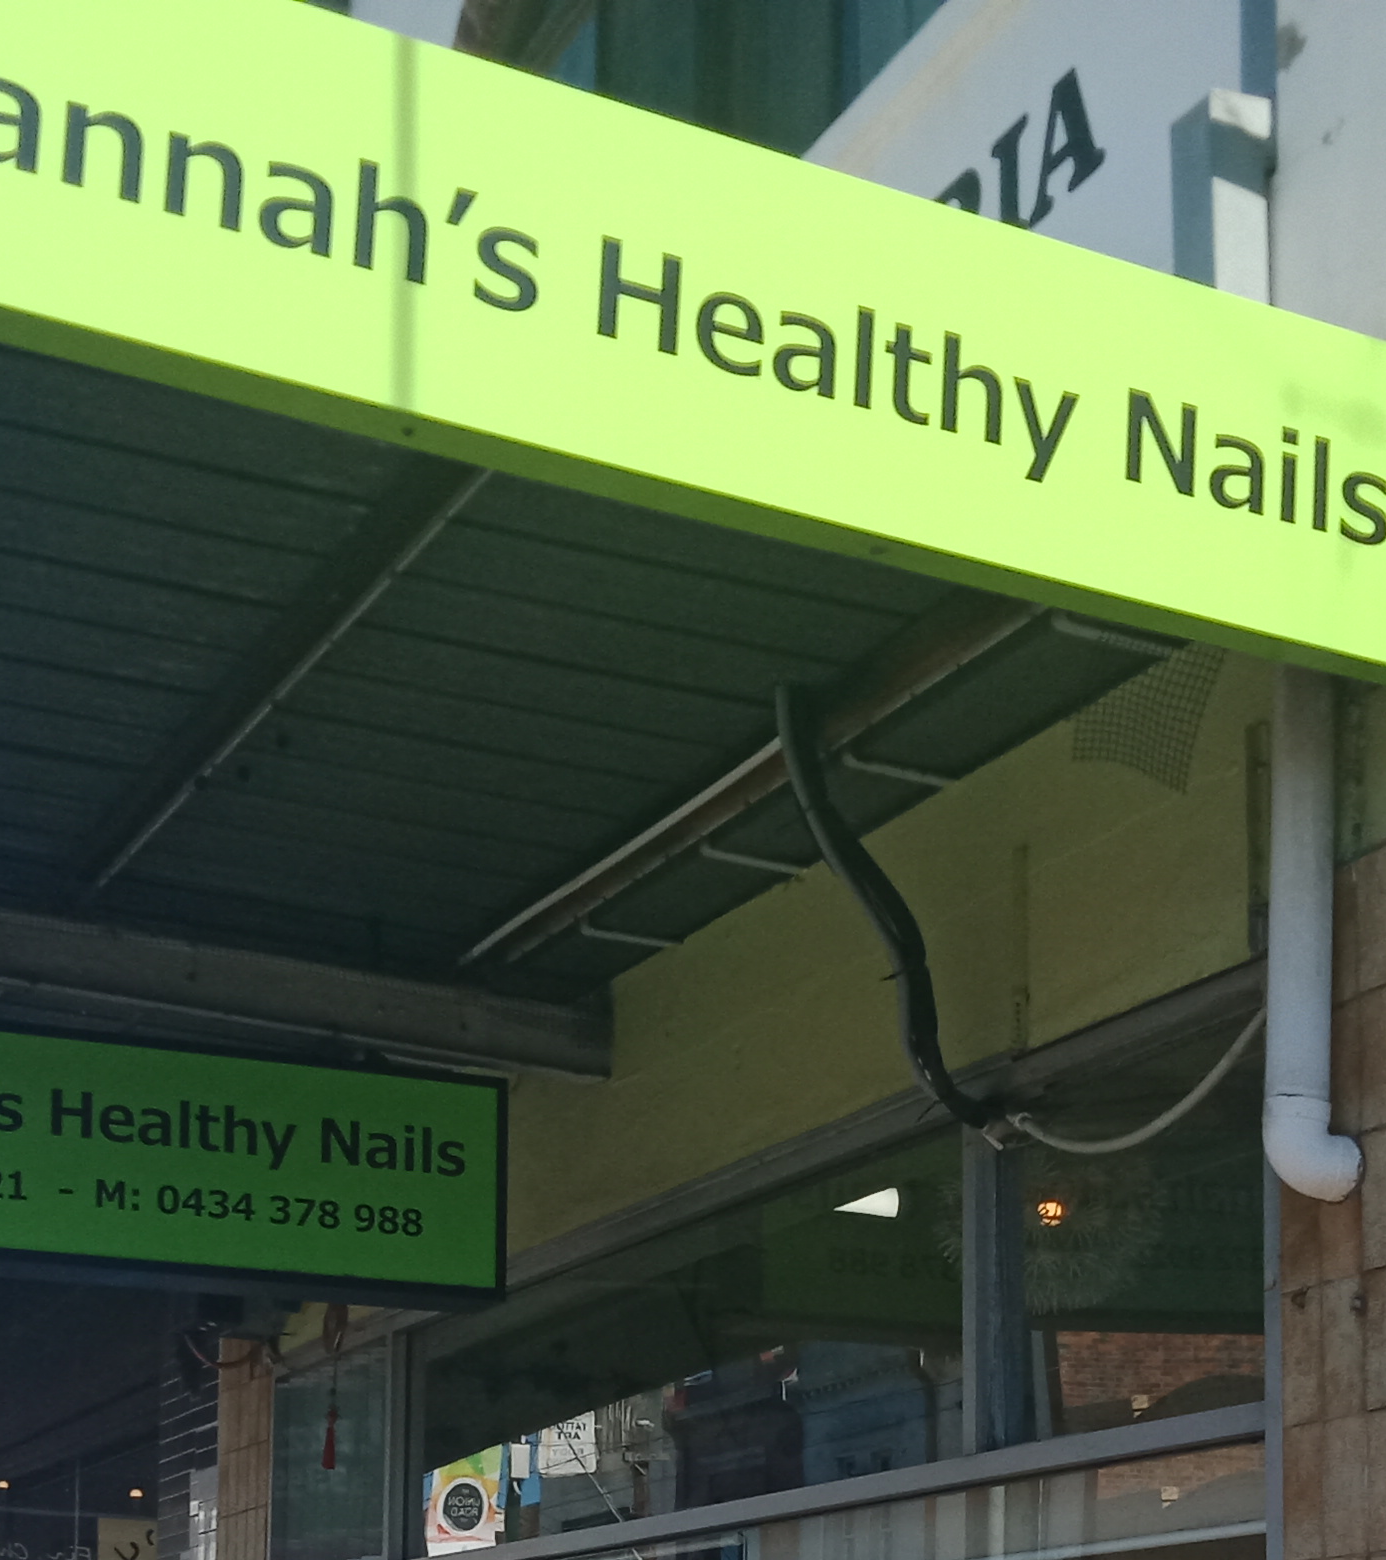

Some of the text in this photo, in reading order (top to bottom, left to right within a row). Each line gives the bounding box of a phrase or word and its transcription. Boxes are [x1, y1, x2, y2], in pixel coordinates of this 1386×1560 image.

[596, 234, 1079, 482] Healthy
[50, 1088, 297, 1170] Healthy
[320, 1119, 467, 1178] Nails
[94, 1179, 142, 1212] M:
[157, 1184, 256, 1223] 0434
[269, 1196, 341, 1231] 378
[353, 1204, 425, 1239] 988
